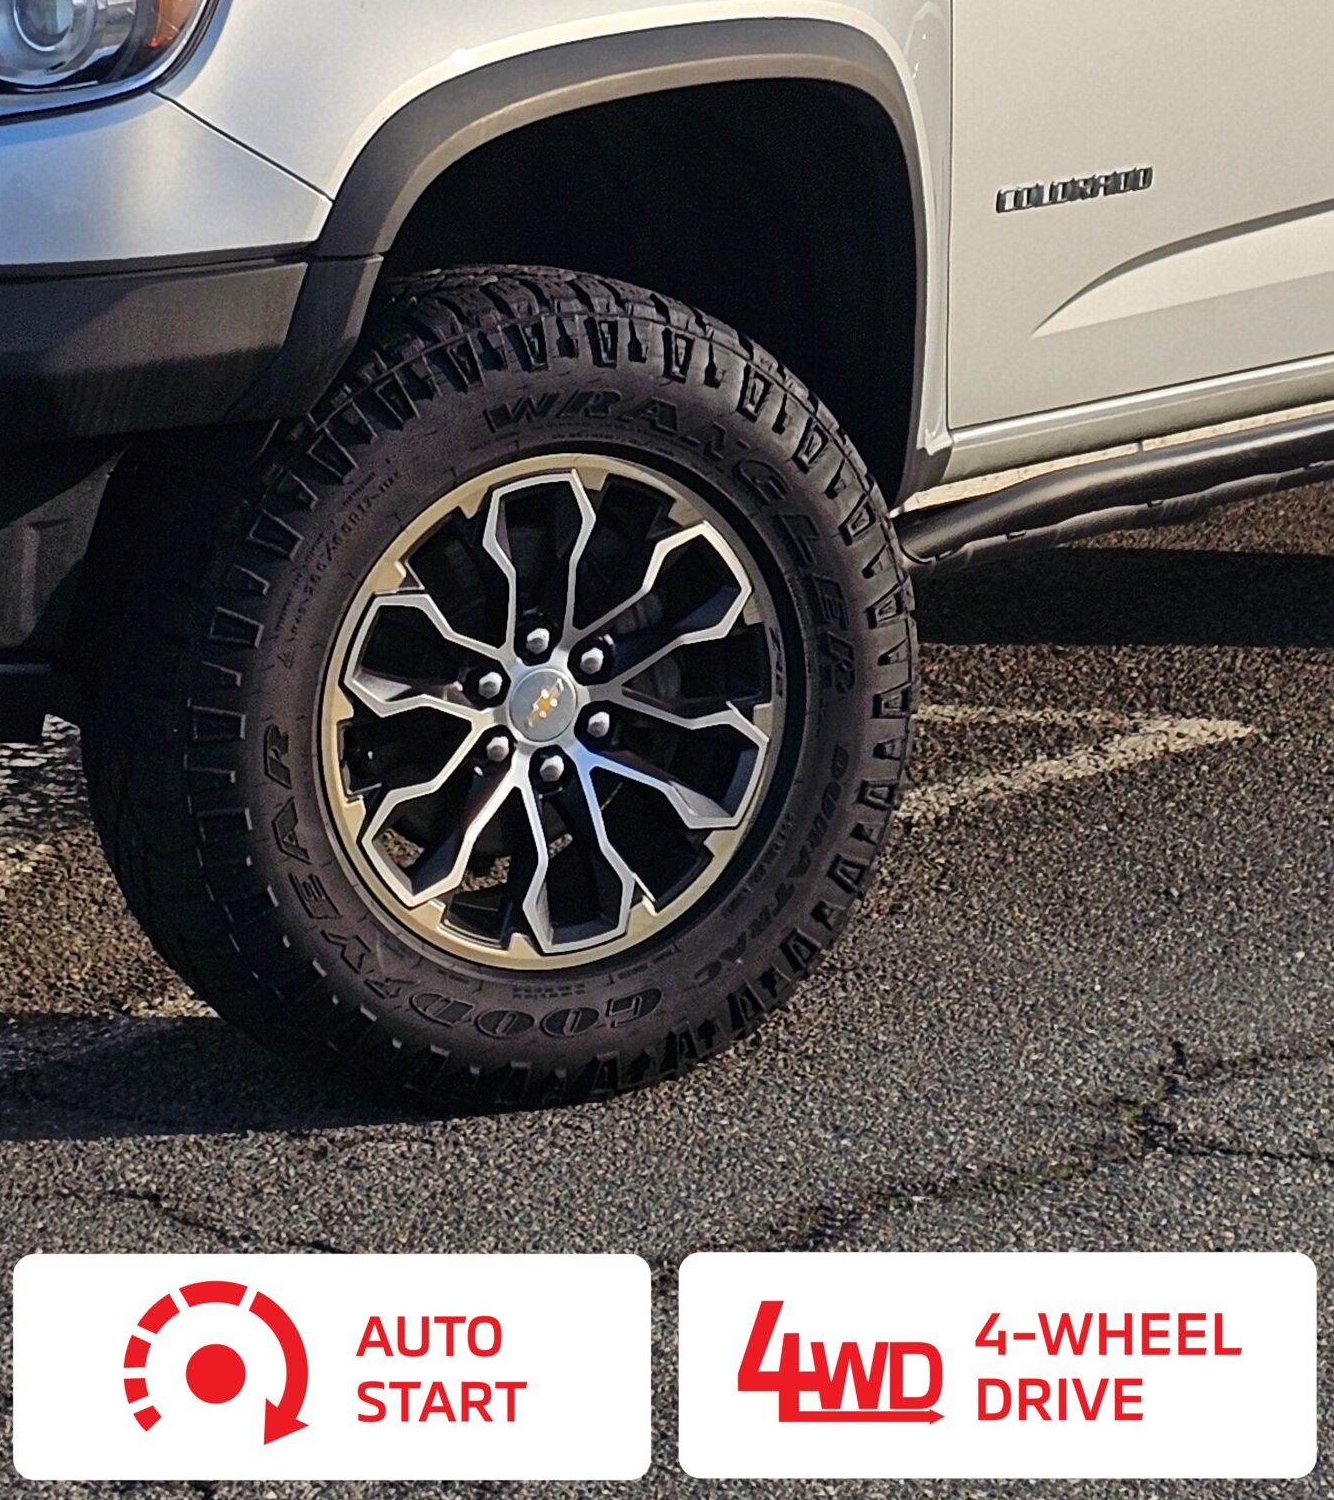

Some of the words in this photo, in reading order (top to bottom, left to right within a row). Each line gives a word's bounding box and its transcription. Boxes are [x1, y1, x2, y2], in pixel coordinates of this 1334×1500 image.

[996, 166, 1153, 213] COLORADO
[482, 386, 857, 692] WRANGLER
[261, 722, 664, 1039] GOODYEAR
